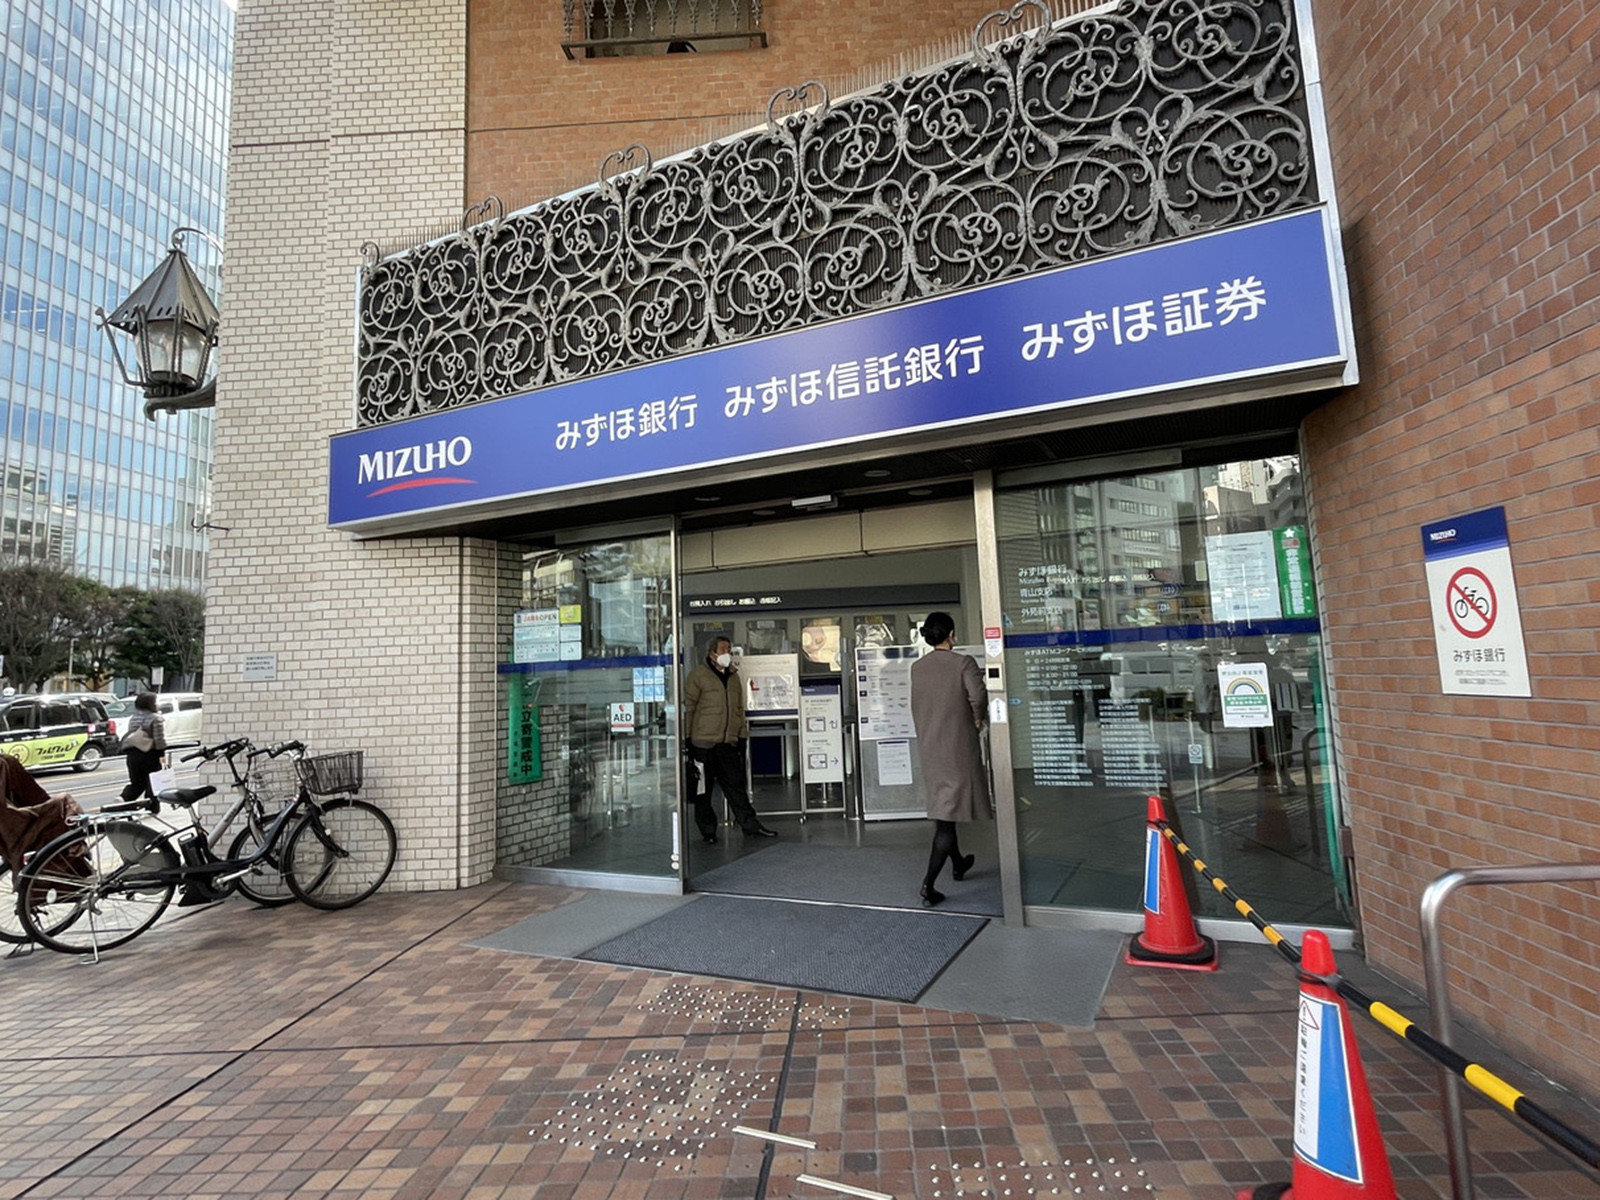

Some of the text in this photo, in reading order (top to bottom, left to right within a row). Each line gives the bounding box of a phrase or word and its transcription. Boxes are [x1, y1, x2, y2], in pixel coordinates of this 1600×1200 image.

[555, 275, 1267, 451] みずほ銀行 みずほ信託銀行 みずほ証券
[358, 436, 473, 485] MIZUHO
[1453, 648, 1505, 663] みずほ銀行
[613, 713, 632, 722] AED
